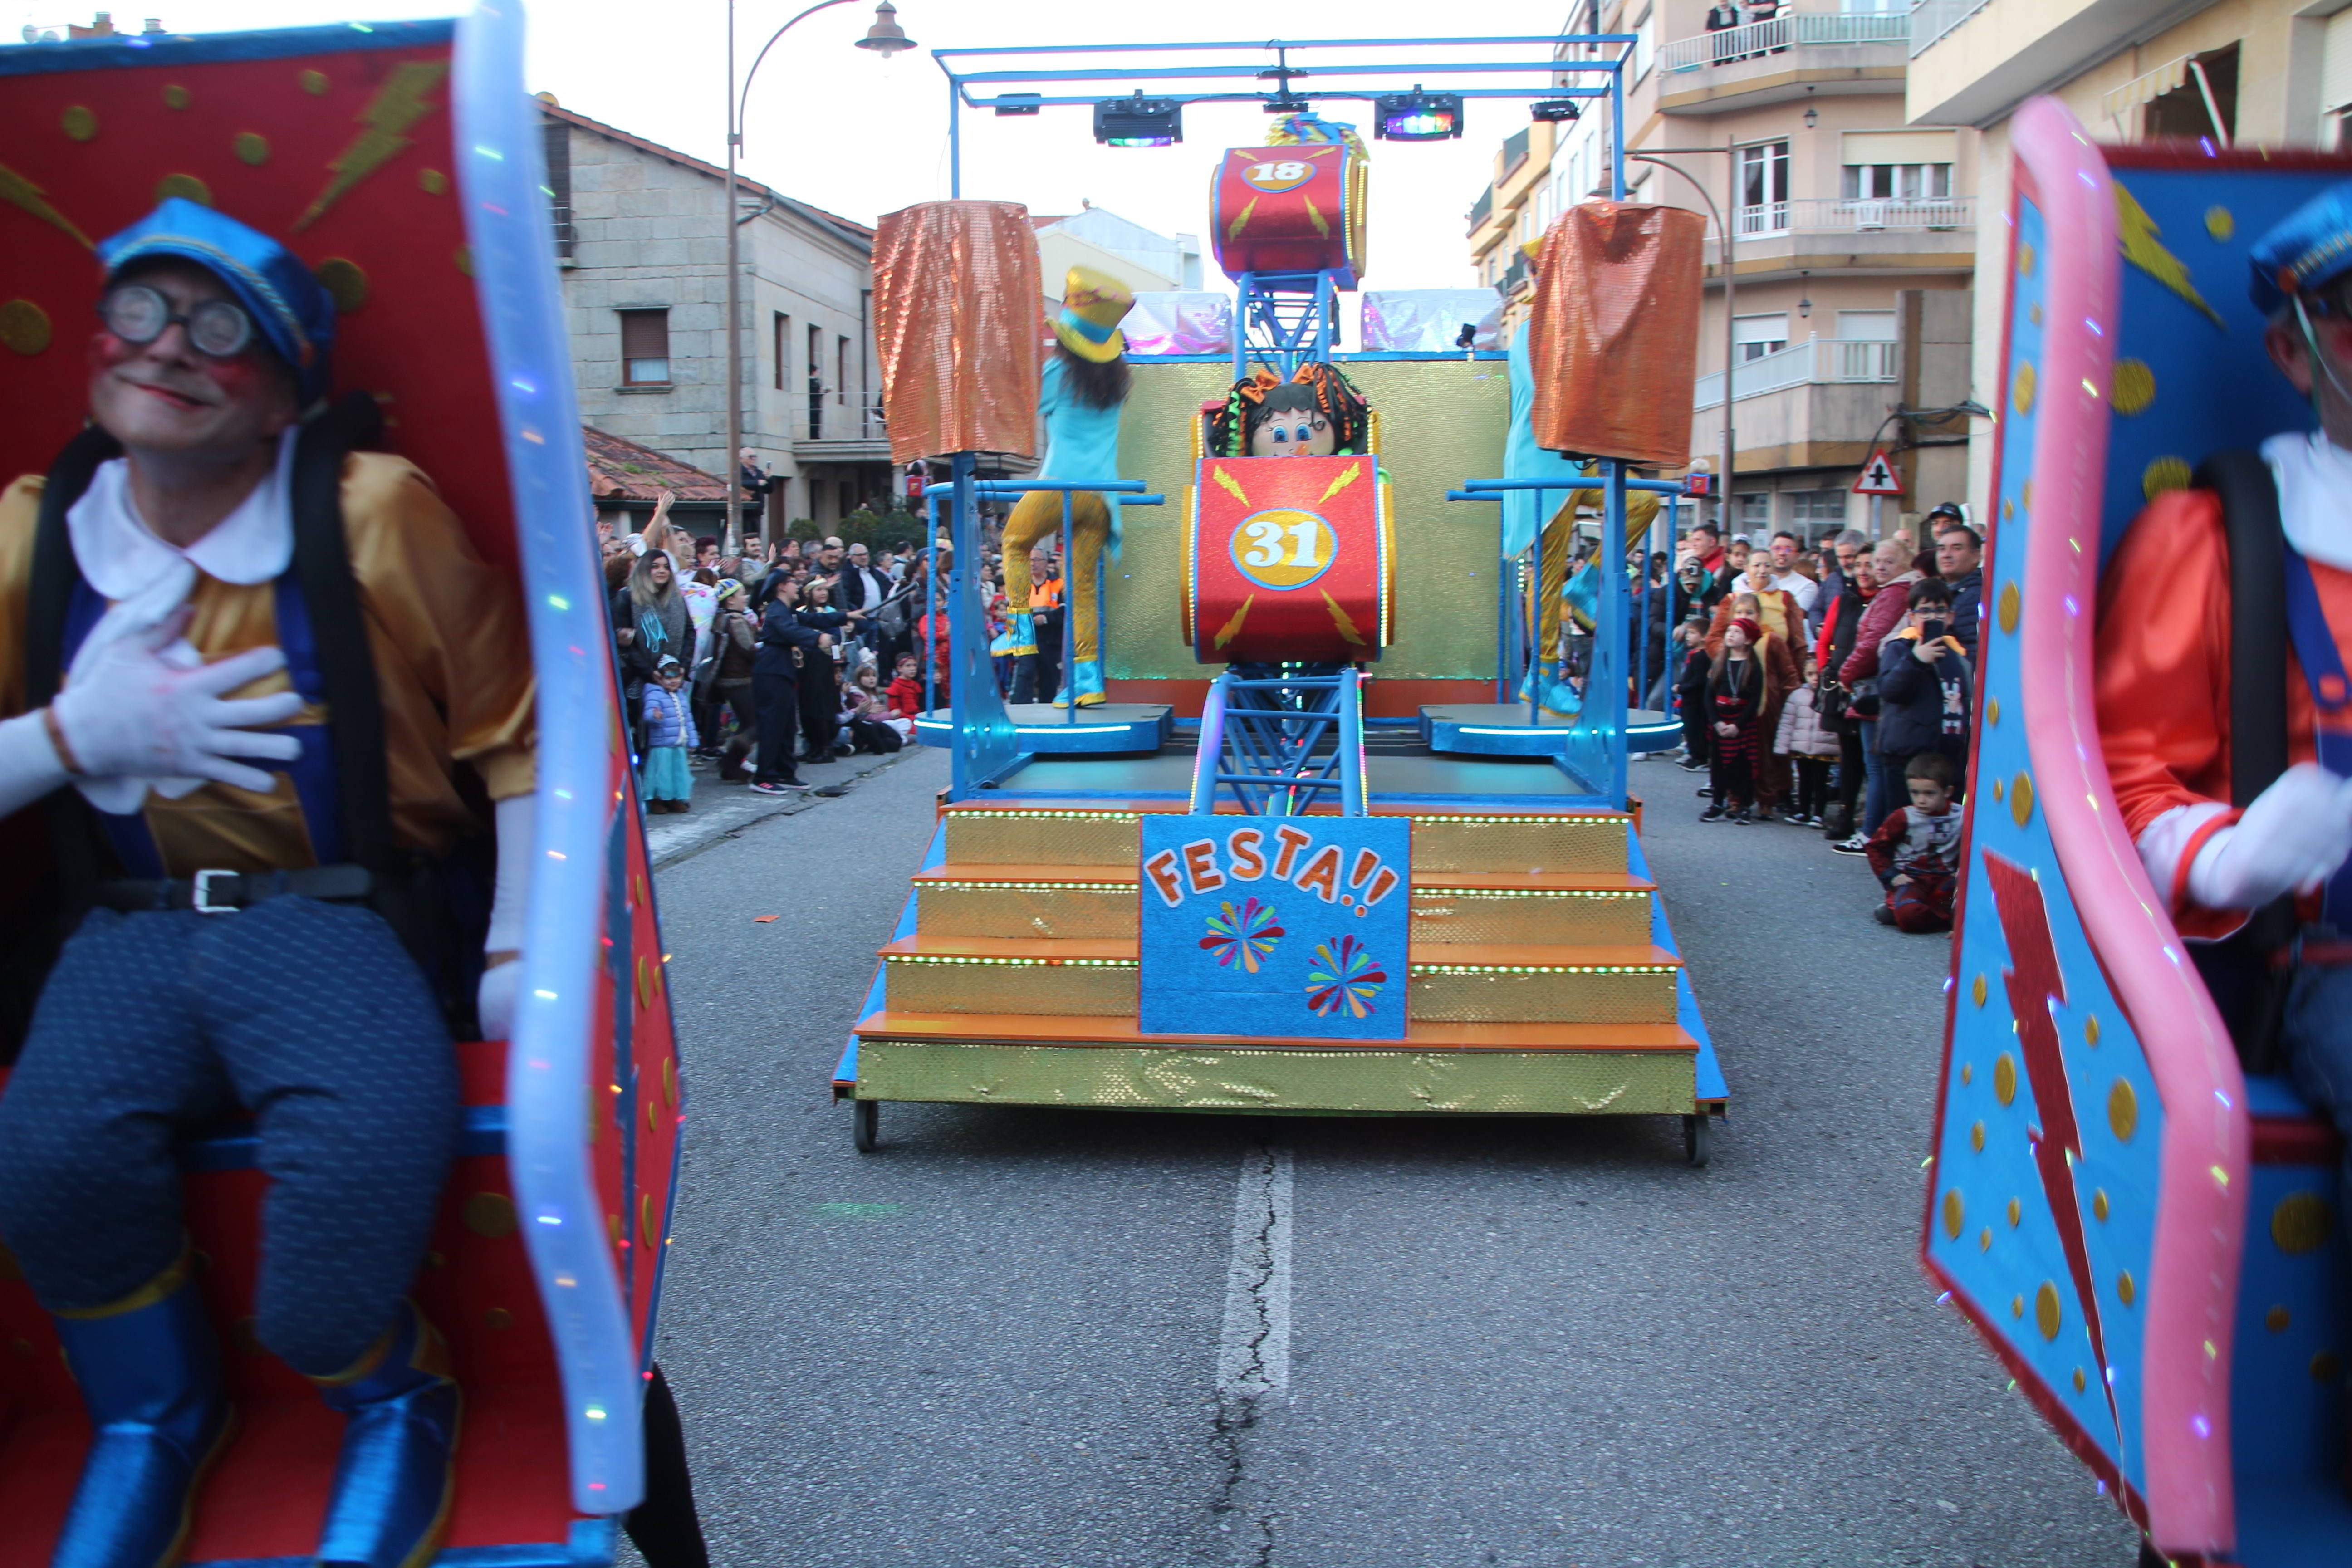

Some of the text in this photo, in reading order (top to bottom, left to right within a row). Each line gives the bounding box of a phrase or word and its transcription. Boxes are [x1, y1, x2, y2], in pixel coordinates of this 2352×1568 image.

[1252, 162, 1305, 181] 18
[1245, 521, 1319, 567] 31
[1144, 823, 1400, 918] FESTA!!
